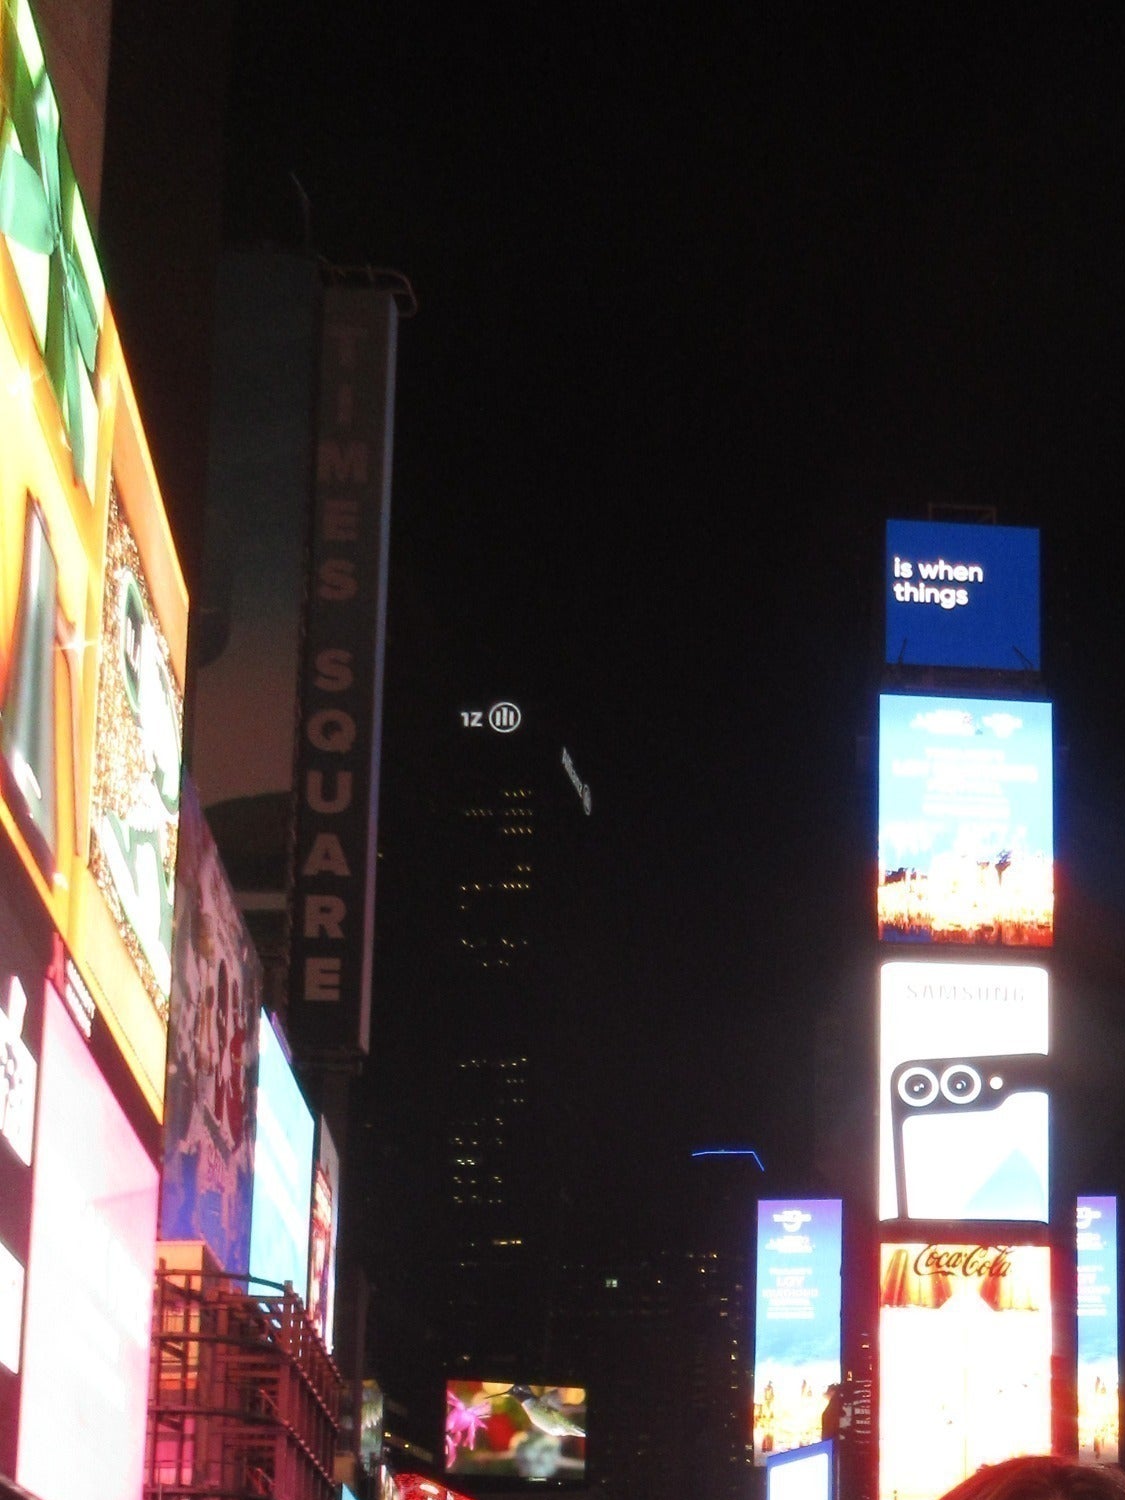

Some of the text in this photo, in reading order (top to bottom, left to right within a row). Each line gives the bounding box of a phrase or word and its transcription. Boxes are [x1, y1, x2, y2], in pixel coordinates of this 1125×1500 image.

[893, 556, 984, 583] is when
[893, 582, 969, 610] things
[302, 649, 357, 1001] SQUARE
